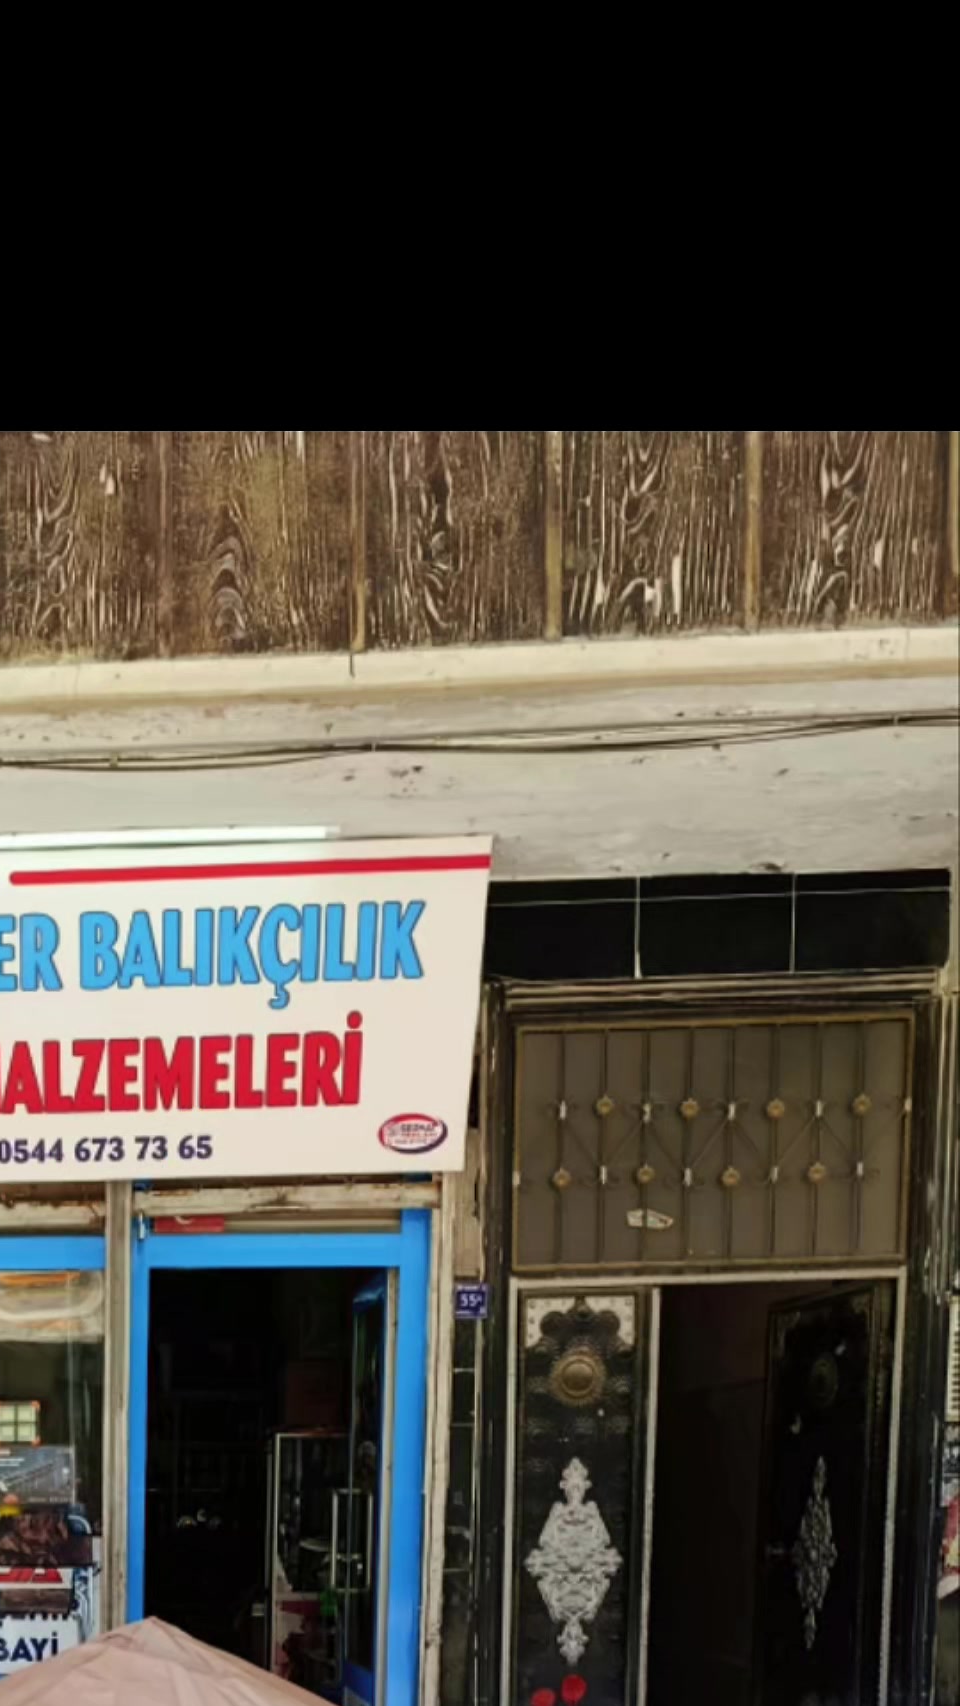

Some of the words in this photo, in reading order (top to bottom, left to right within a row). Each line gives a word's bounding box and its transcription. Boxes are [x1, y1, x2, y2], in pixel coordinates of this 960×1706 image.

[79, 900, 426, 1009] BALIKÇILIK
[74, 1137, 125, 1162] 673
[135, 1137, 169, 1161] 73
[178, 1135, 213, 1160] 65
